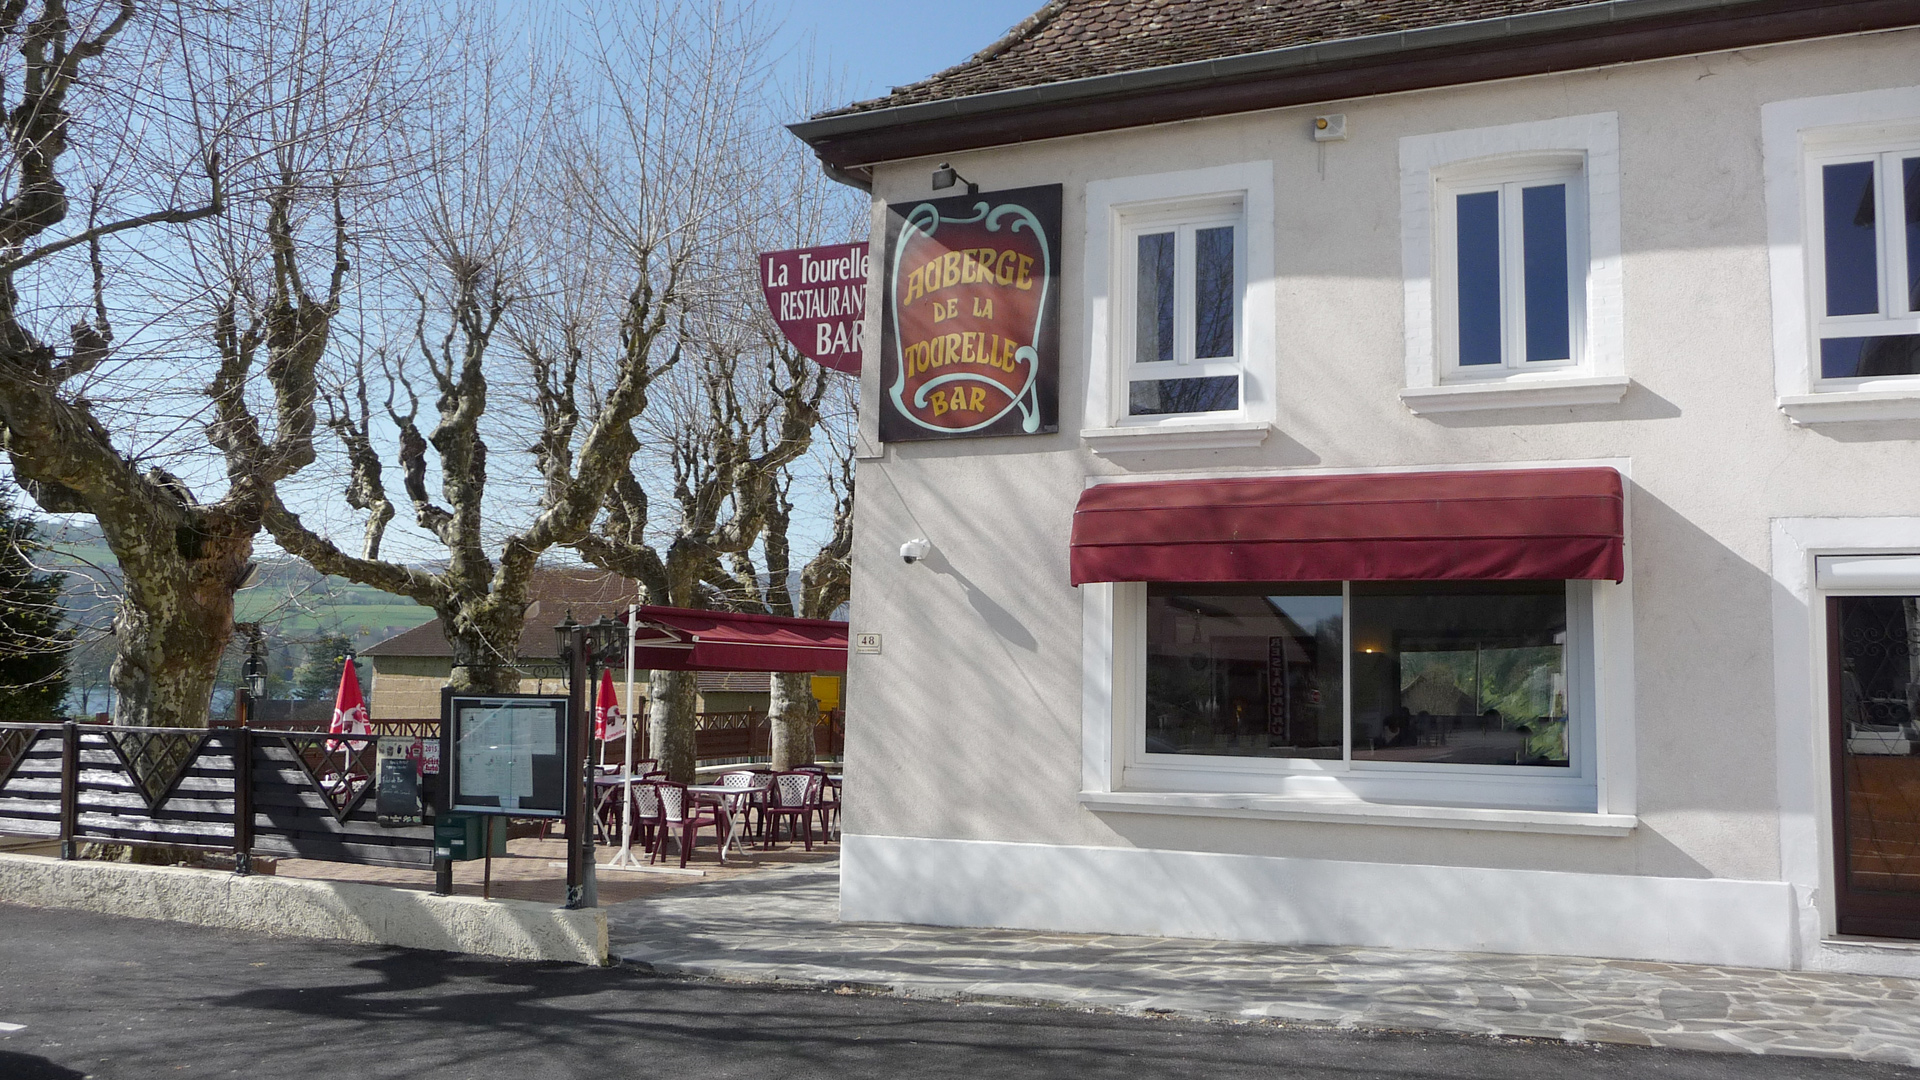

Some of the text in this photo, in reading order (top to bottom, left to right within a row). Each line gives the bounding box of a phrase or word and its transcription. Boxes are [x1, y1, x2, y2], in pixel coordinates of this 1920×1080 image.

[768, 247, 869, 288] La Tourelle
[903, 248, 1034, 306] AUBERGE
[933, 297, 993, 323] DE LA
[816, 320, 865, 355] BAR
[905, 331, 1018, 379] TOURELLE
[930, 386, 986, 417] BAR
[861, 635, 875, 645] 48
